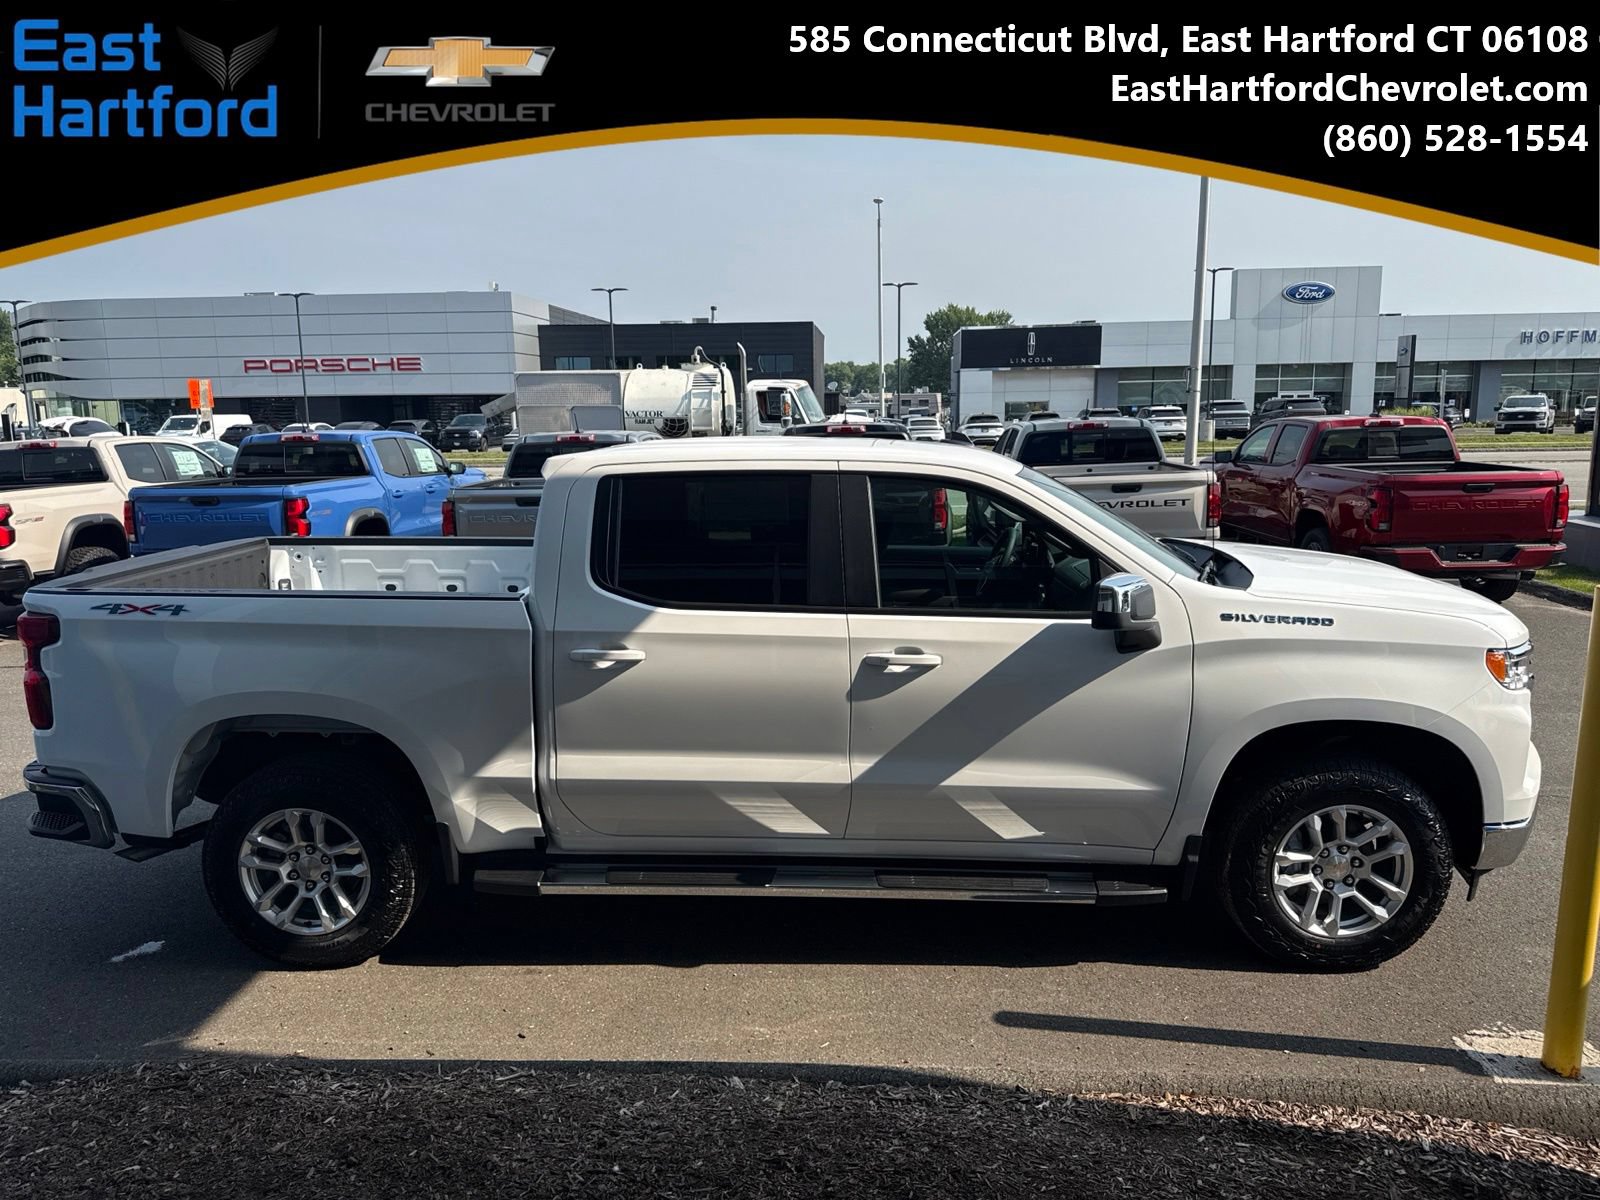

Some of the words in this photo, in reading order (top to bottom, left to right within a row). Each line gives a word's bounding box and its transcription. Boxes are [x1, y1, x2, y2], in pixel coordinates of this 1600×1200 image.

[1295, 285, 1326, 299] Ford
[1520, 330, 1600, 344] HOFFM
[243, 356, 423, 374] PORSCHE
[624, 410, 664, 418] VACTOR
[1412, 500, 1541, 511] CHEVROLET
[147, 512, 264, 523] CHEVROLET
[468, 513, 538, 523] CHEVR
[1219, 613, 1335, 627] SILVERADO
